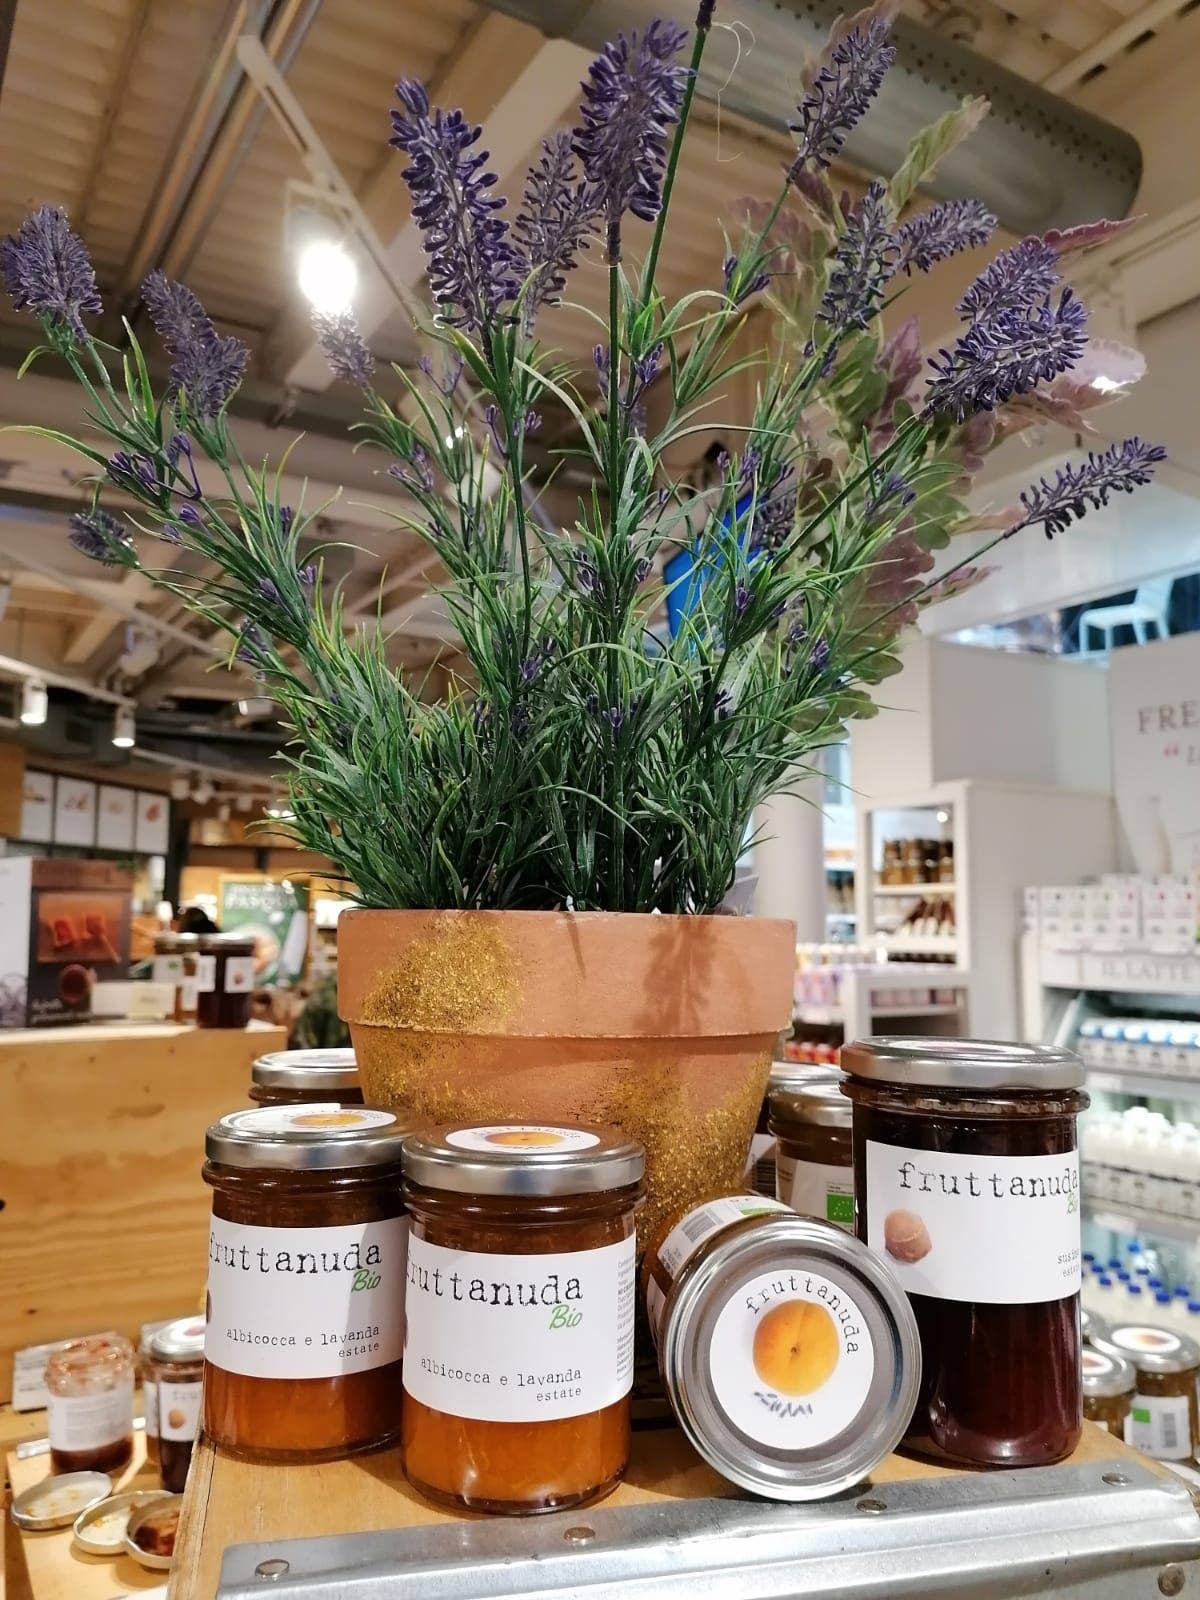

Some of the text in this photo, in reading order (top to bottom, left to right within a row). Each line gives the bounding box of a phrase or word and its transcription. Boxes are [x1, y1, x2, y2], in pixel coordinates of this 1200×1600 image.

[1138, 700, 1200, 732] FRE
[898, 1161, 1079, 1198] fruttanuda
[209, 1231, 382, 1274] fruttanuda
[351, 1269, 381, 1293] Bio
[549, 1304, 583, 1330] Bio
[745, 1275, 860, 1354] fruttanuda
[226, 1325, 380, 1346] albicocca e lavanda
[338, 1341, 380, 1358] estate
[421, 1357, 582, 1387] albicocca e lavanda
[536, 1386, 582, 1402] estate
